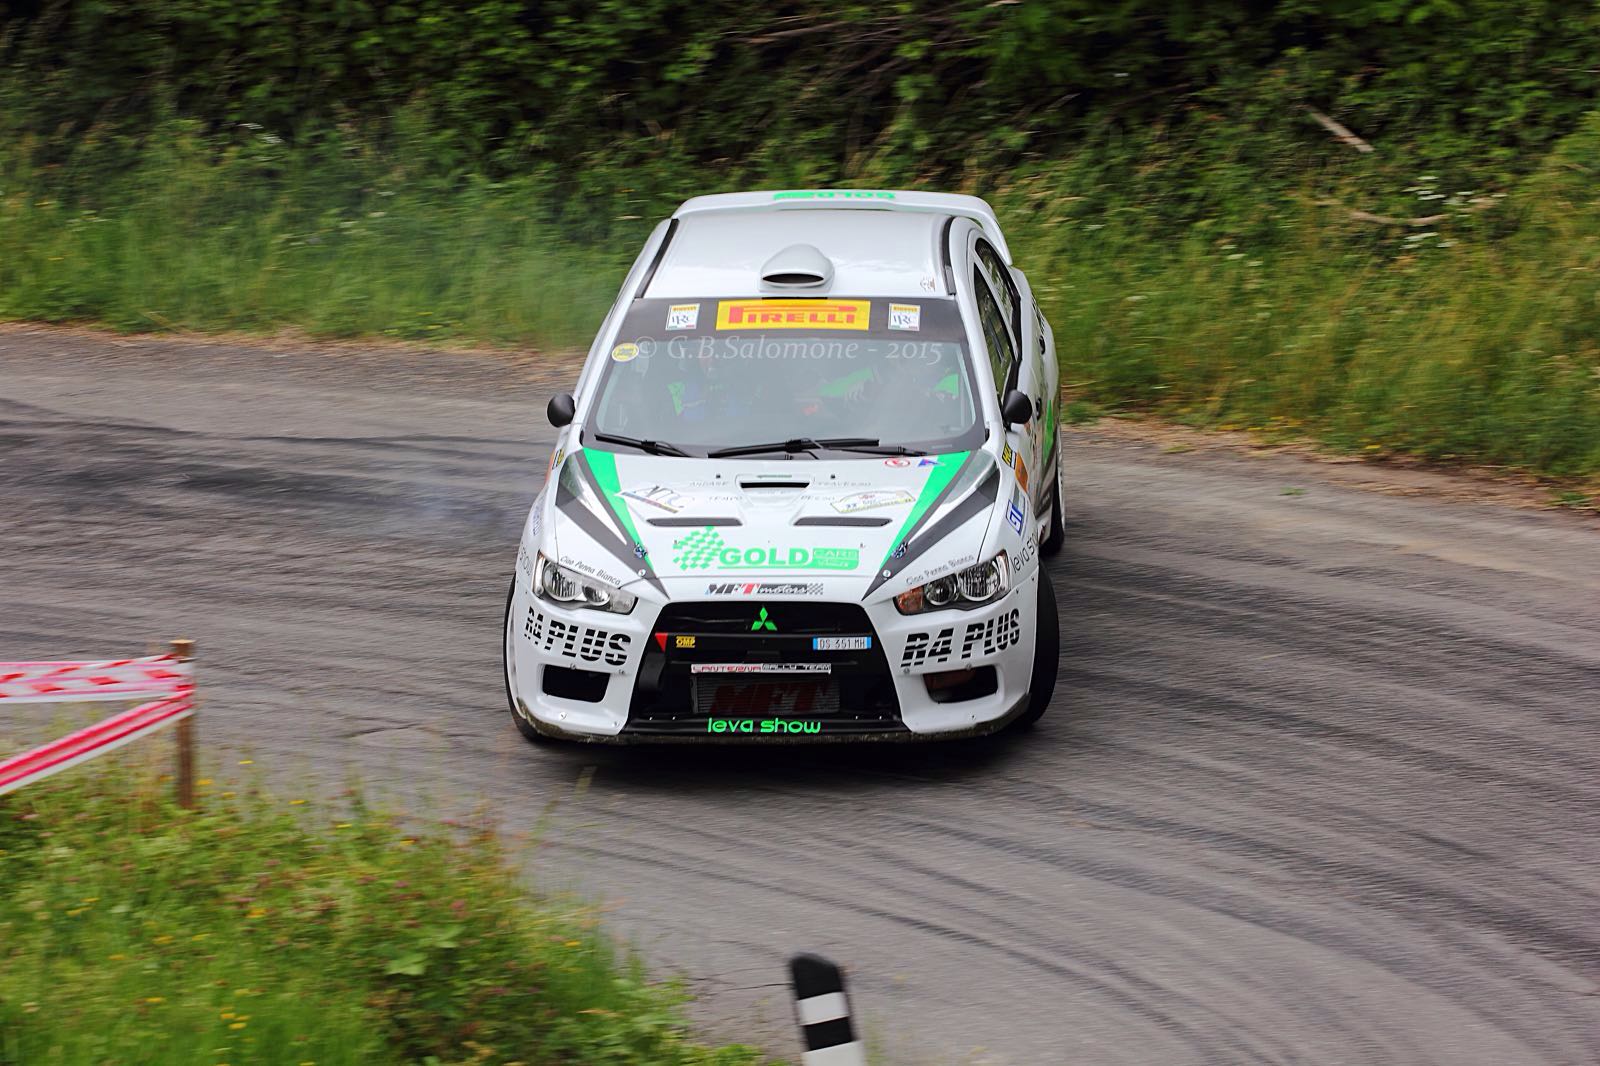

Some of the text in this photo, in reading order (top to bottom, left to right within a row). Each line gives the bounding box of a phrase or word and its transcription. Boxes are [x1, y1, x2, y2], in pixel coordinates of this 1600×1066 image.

[729, 305, 858, 325] PIRELLI
[719, 547, 810, 567] GOLD
[544, 620, 632, 667] PLUS
[676, 636, 696, 648] OMP
[835, 638, 851, 649] 351
[901, 608, 1021, 667] R4 PLUS
[692, 664, 762, 673] LANTERNA
[707, 717, 822, 733] leva show
